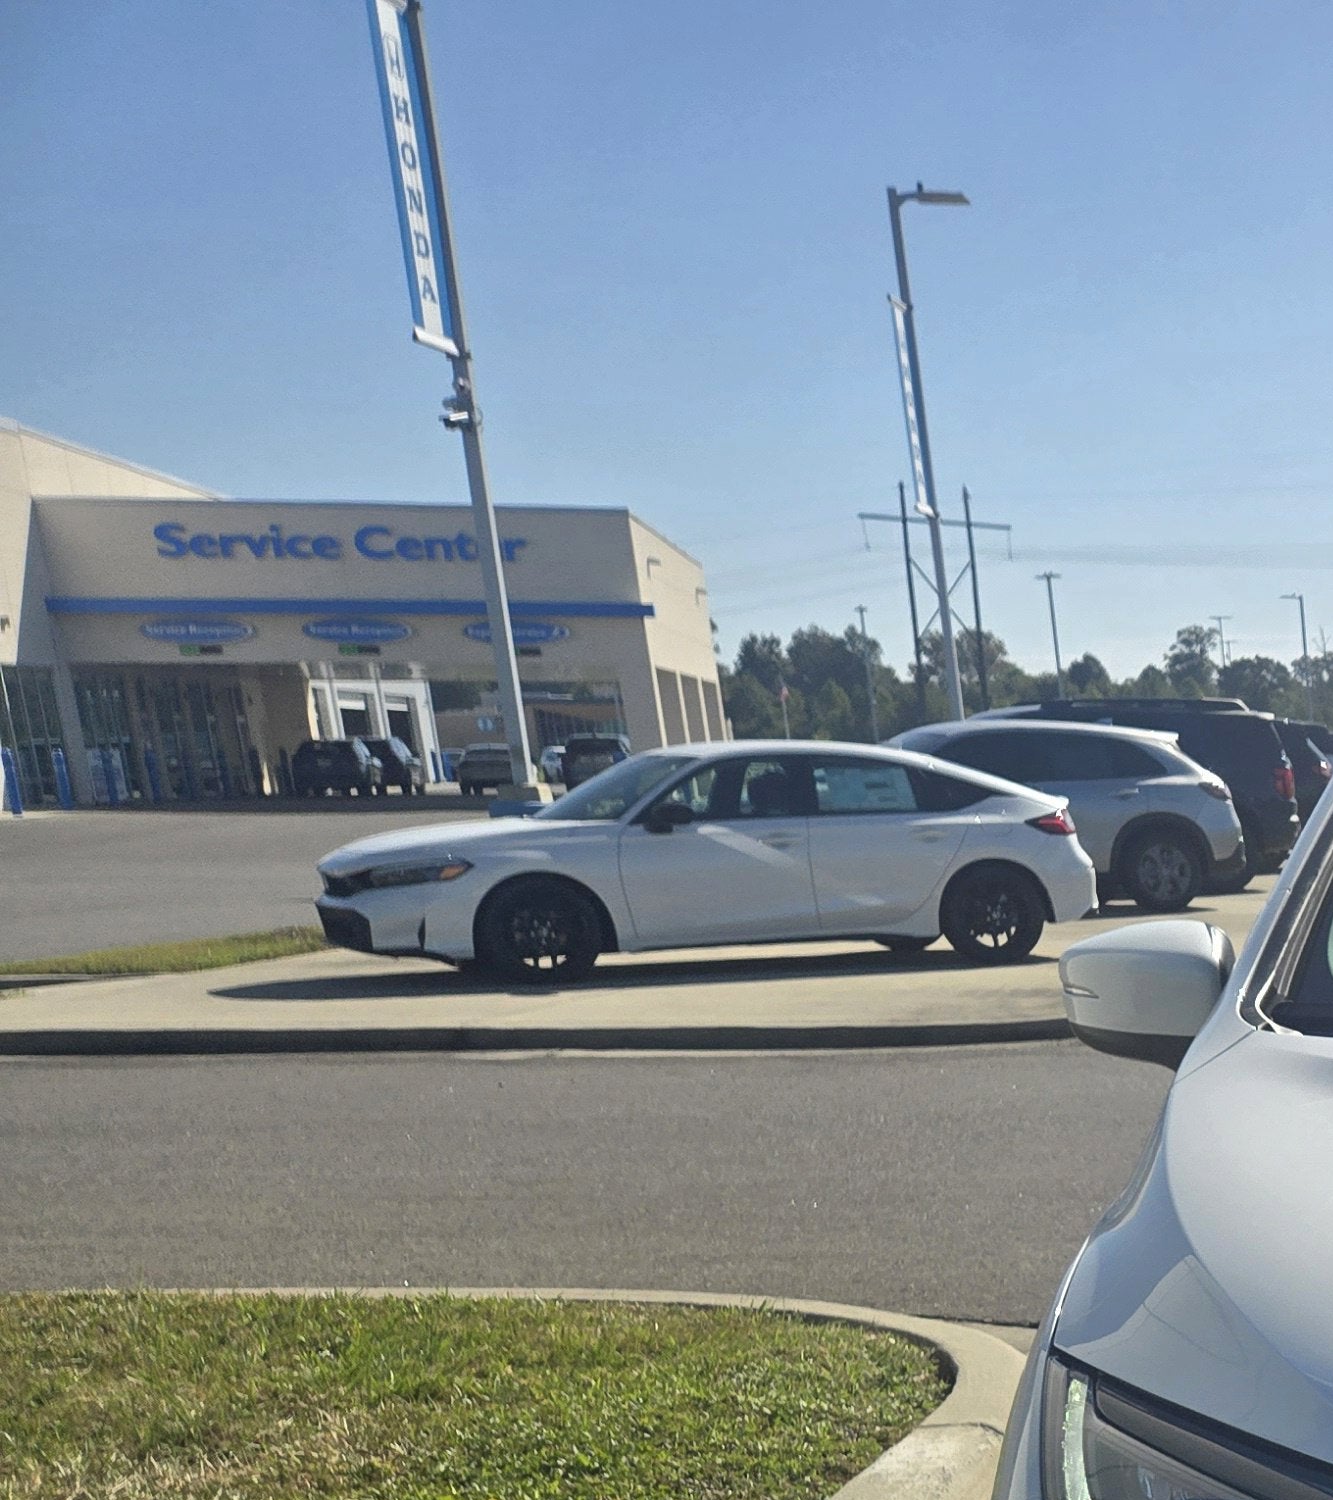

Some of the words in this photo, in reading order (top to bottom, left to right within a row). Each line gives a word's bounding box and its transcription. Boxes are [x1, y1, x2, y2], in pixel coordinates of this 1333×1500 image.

[392, 95, 438, 305] HONDA
[153, 521, 344, 561] Service
[354, 523, 528, 563] Centr
